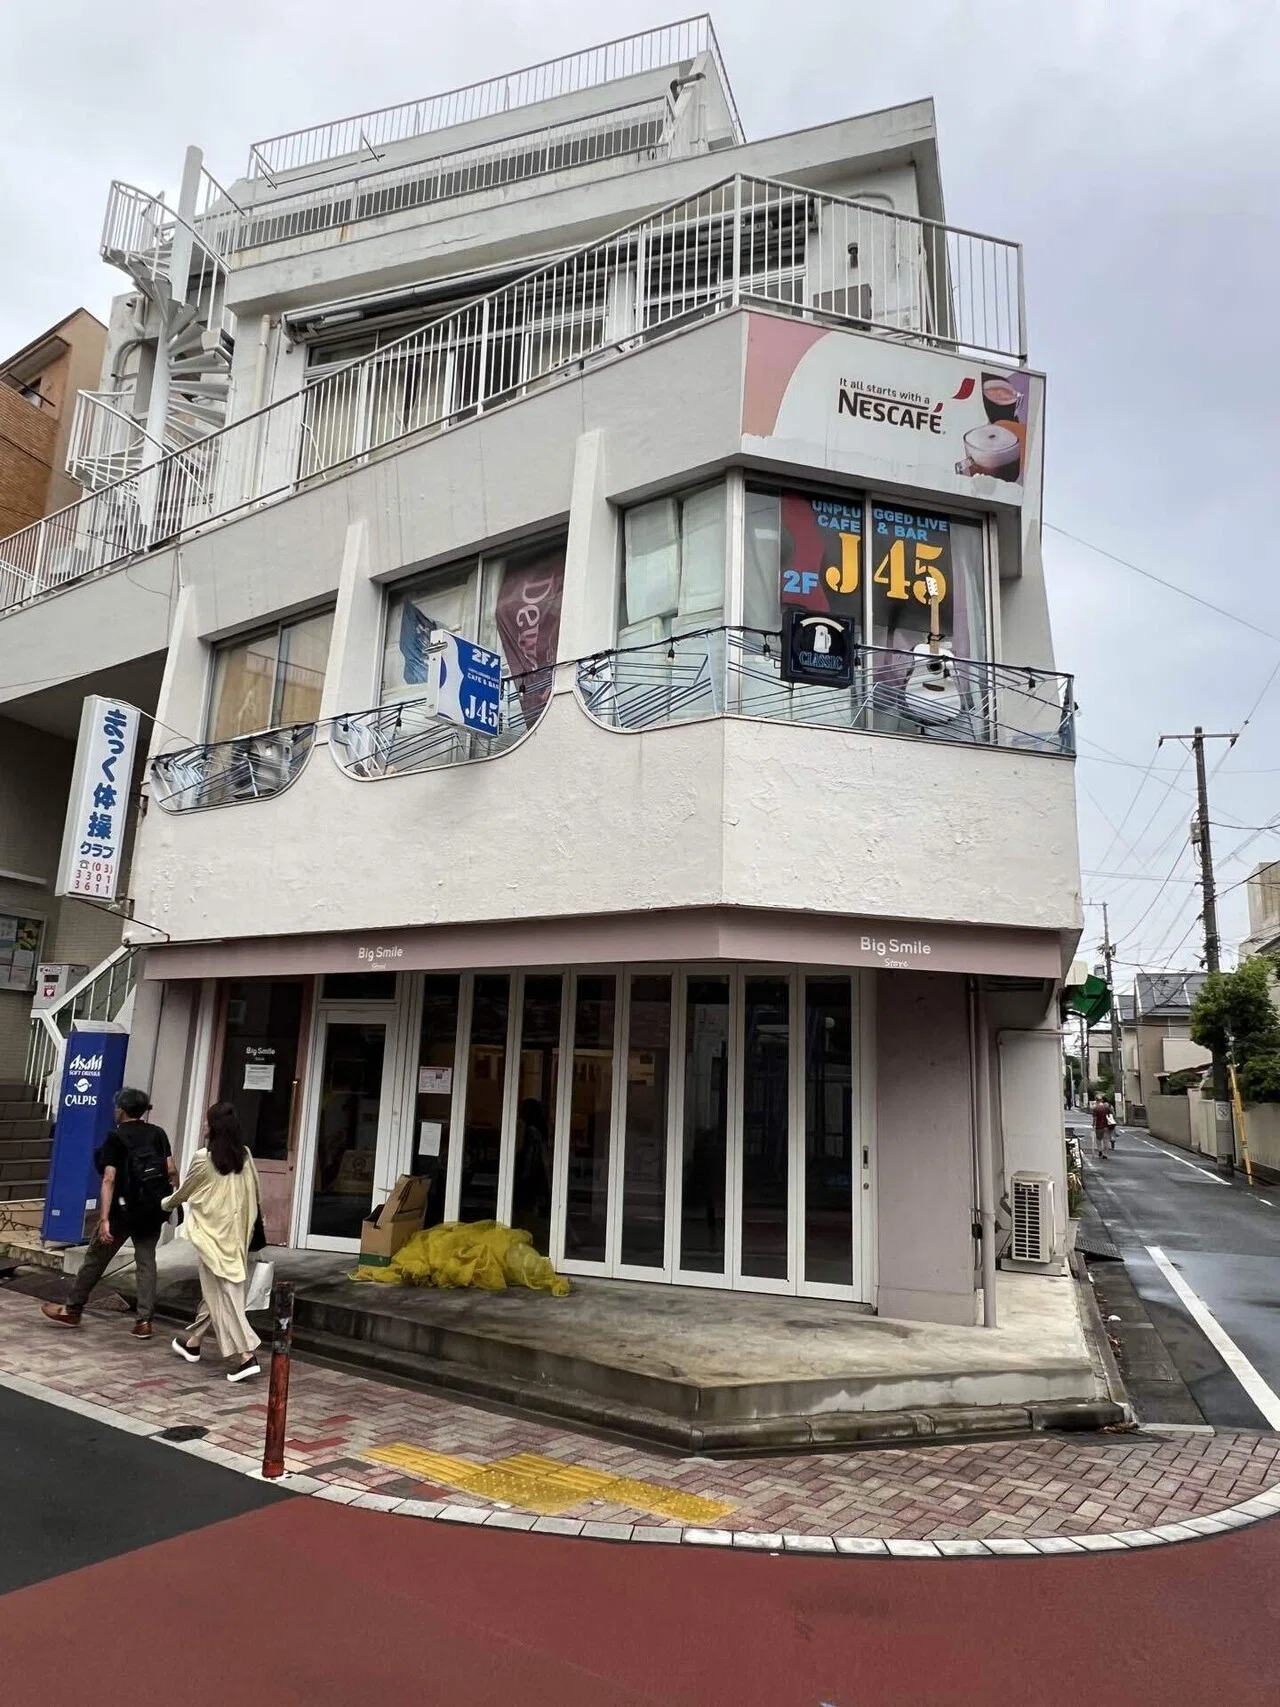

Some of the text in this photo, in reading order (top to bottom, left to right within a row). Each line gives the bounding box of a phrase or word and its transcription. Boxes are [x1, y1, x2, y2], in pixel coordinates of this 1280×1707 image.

[839, 378, 848, 387] It
[850, 381, 864, 391] all
[866, 384, 897, 397] starts
[900, 391, 921, 402] with
[838, 388, 943, 434] NESCAFÉ
[817, 514, 928, 541] CAFE & BAR
[917, 515, 948, 532] LIVE
[783, 570, 819, 595] 2F
[471, 648, 491, 666] 2F
[359, 946, 403, 962] Big Smile
[860, 936, 931, 956] Big Smile
[70, 1054, 103, 1071] Asahi
[65, 1094, 97, 1107] CALPIS
